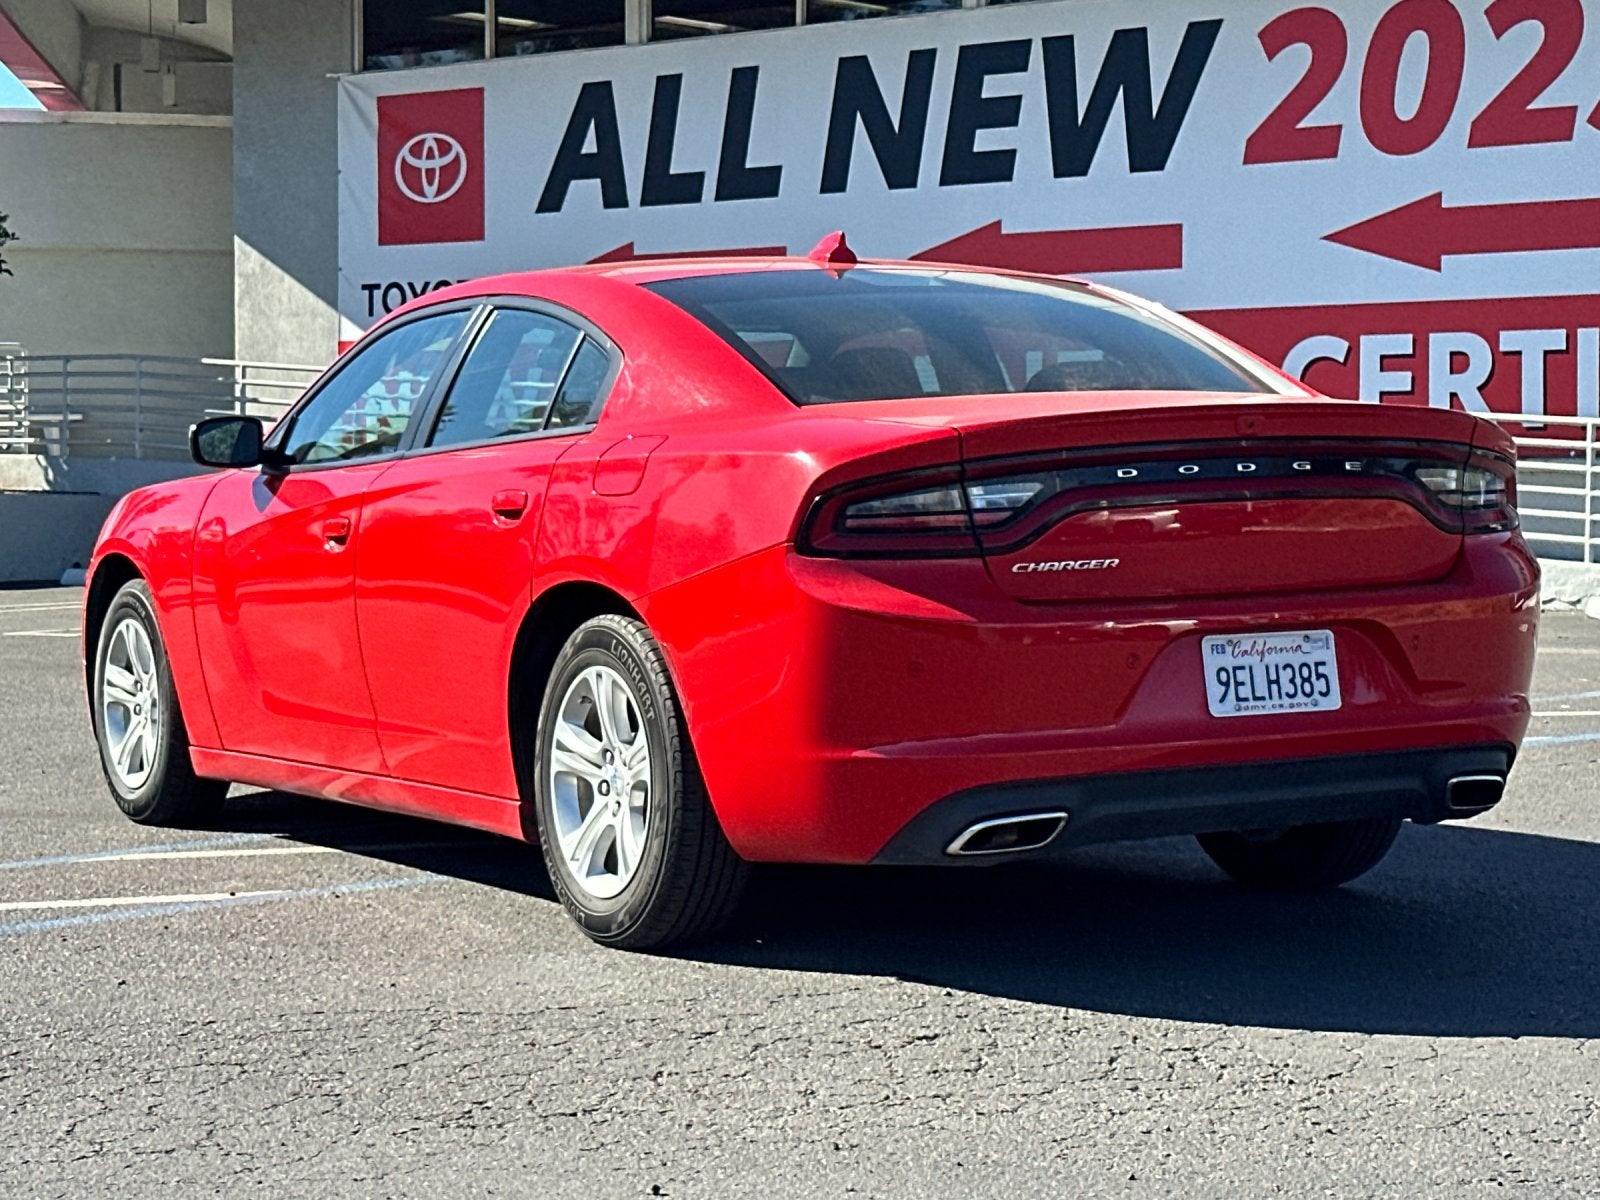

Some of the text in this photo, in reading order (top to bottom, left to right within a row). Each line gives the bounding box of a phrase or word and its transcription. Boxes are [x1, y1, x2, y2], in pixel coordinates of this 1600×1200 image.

[534, 0, 1600, 214] ALL NEW 202
[1117, 461, 1364, 478] DODGE
[1011, 558, 1120, 573] CHARGER
[1210, 643, 1227, 655] FEB
[1231, 638, 1312, 663] California
[610, 639, 655, 720] LIONHART
[1216, 661, 1331, 704] 9ELH385
